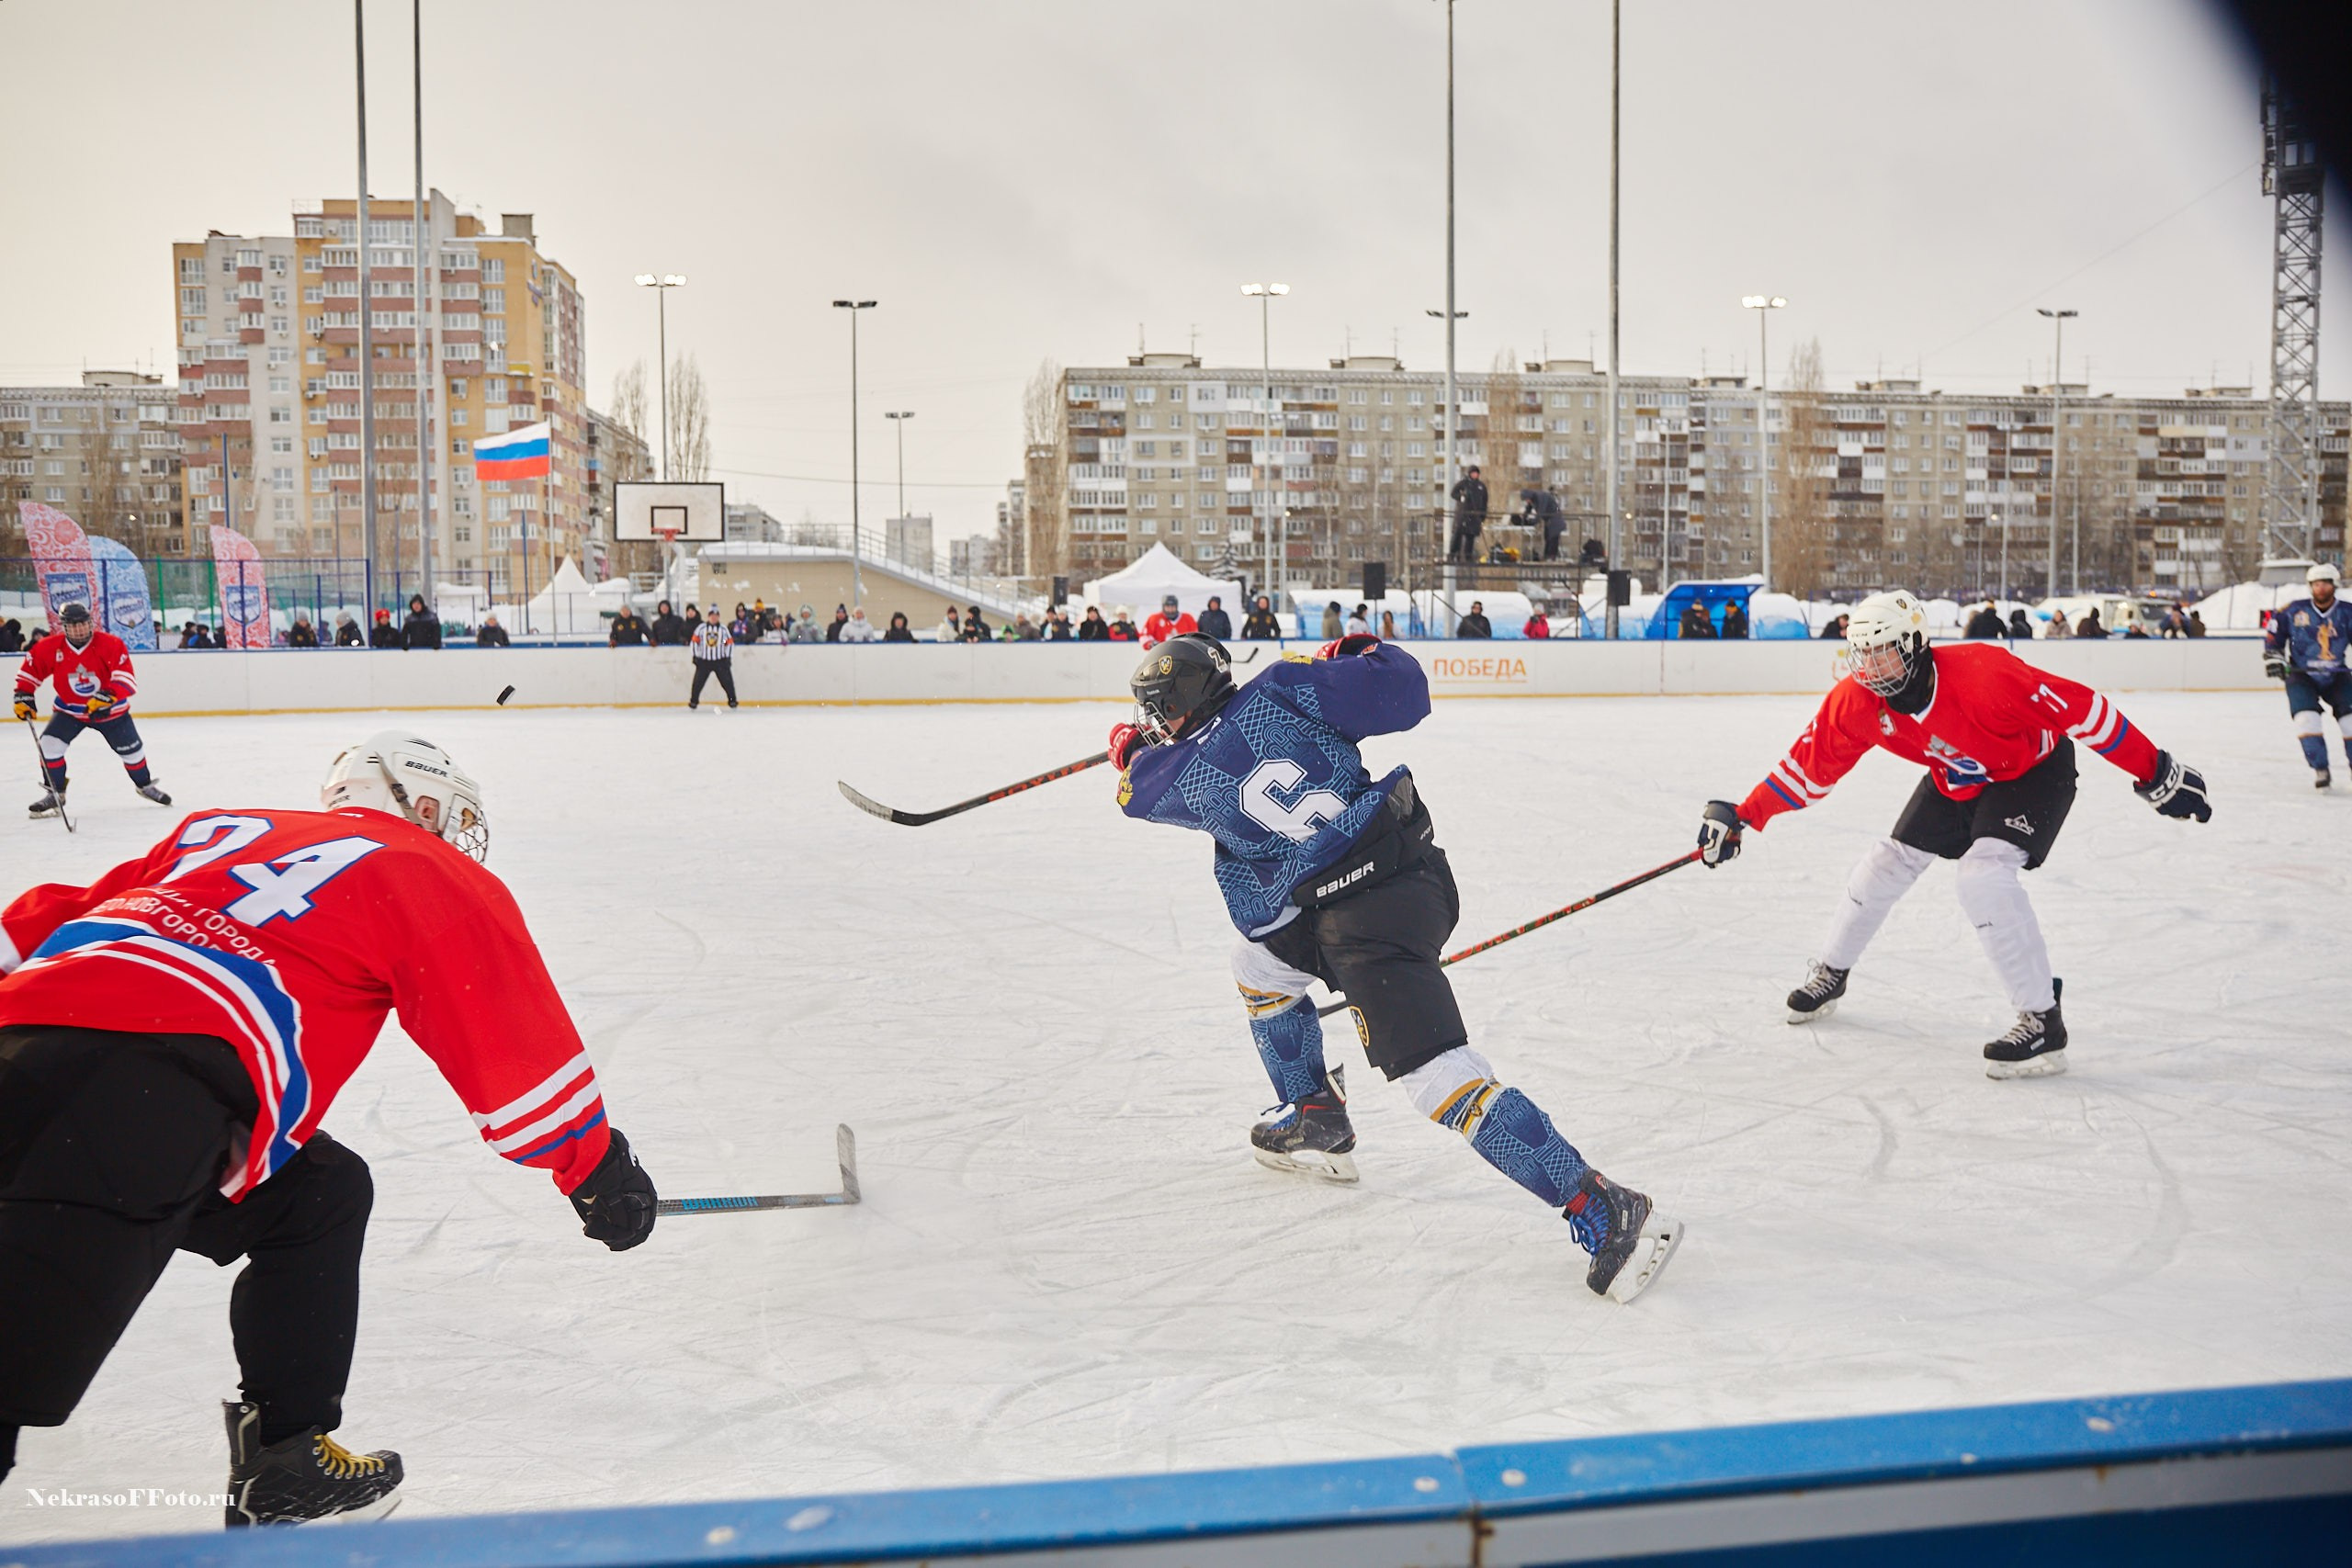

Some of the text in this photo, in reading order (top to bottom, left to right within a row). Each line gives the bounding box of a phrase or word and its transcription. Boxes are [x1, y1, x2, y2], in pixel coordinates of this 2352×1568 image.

[1433, 658, 1527, 680] ПОБЕДА
[404, 760, 448, 778] BAUER
[159, 813, 388, 929] 24
[1316, 861, 1375, 898] BAUER
